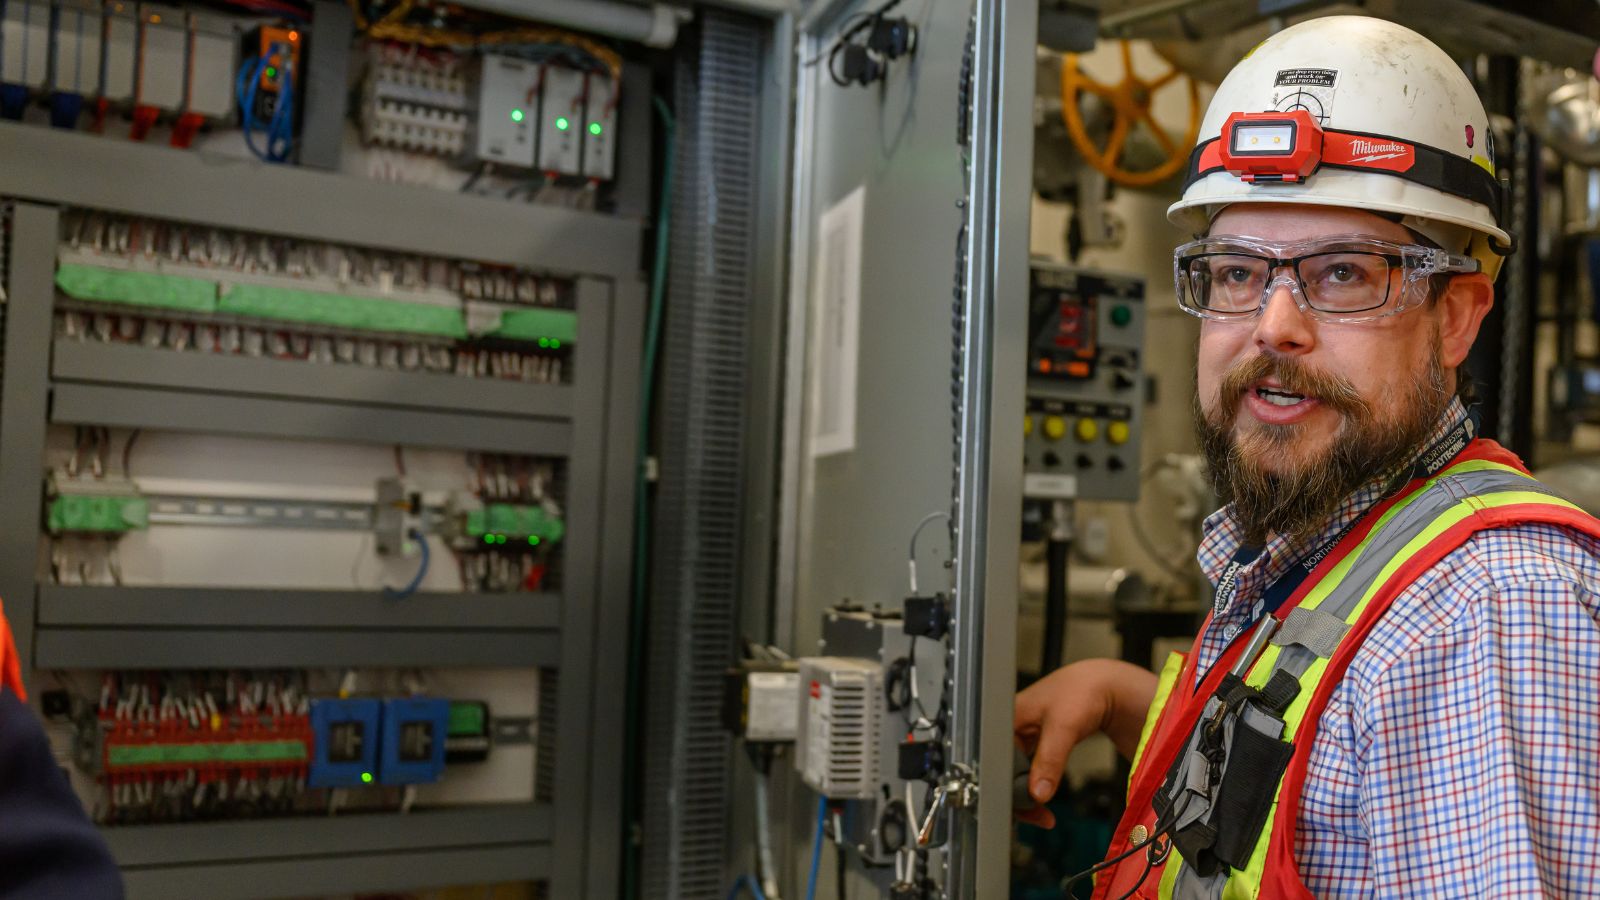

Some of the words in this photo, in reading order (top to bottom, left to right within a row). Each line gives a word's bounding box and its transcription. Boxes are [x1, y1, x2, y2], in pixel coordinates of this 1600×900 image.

[1349, 138, 1406, 157] Milwaukee
[1423, 425, 1466, 466] NORTHWESTERN
[1426, 437, 1466, 475] POLYTECHNIC
